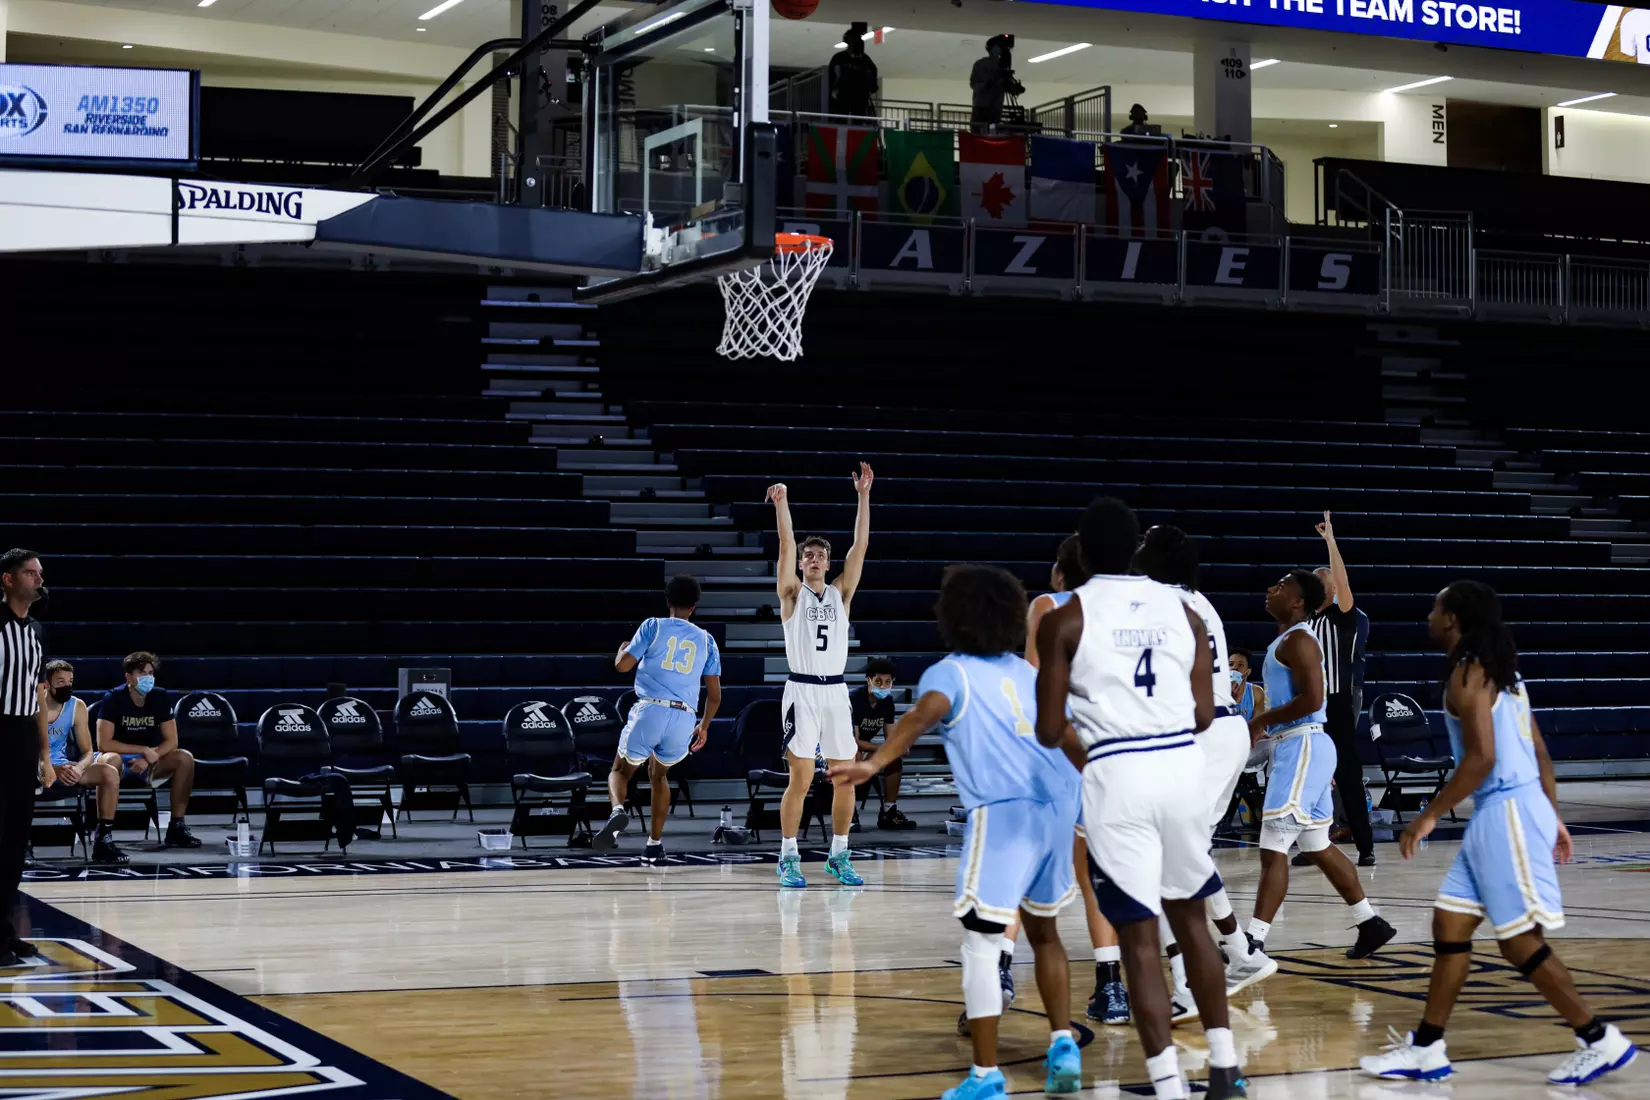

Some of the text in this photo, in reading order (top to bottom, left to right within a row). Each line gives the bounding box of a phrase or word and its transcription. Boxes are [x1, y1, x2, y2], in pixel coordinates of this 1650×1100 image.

[1335, 0, 1414, 23] TEAM
[1421, 0, 1521, 35] STORE!
[1224, 58, 1243, 68] 109
[0, 93, 27, 117] OX
[77, 95, 160, 114] AM1350
[84, 113, 148, 126] RIVERSIDE
[1431, 104, 1445, 144] MEN
[63, 124, 169, 137] SAN BERNARDINO
[806, 606, 836, 622] CBU
[815, 624, 829, 652] 5
[1112, 628, 1169, 648] THOMAS
[661, 635, 698, 675] 13
[1134, 648, 1157, 697] 4
[188, 708, 221, 717] adidas
[410, 707, 442, 716] adidas
[1000, 676, 1035, 736] 1
[331, 715, 366, 723] adidas
[574, 712, 606, 723] adidas
[1385, 709, 1414, 718] adidas
[122, 716, 155, 727] HAWKS
[275, 723, 311, 732] adidas
[521, 720, 556, 729] adidas
[21, 858, 488, 879] CALIFORNIA
